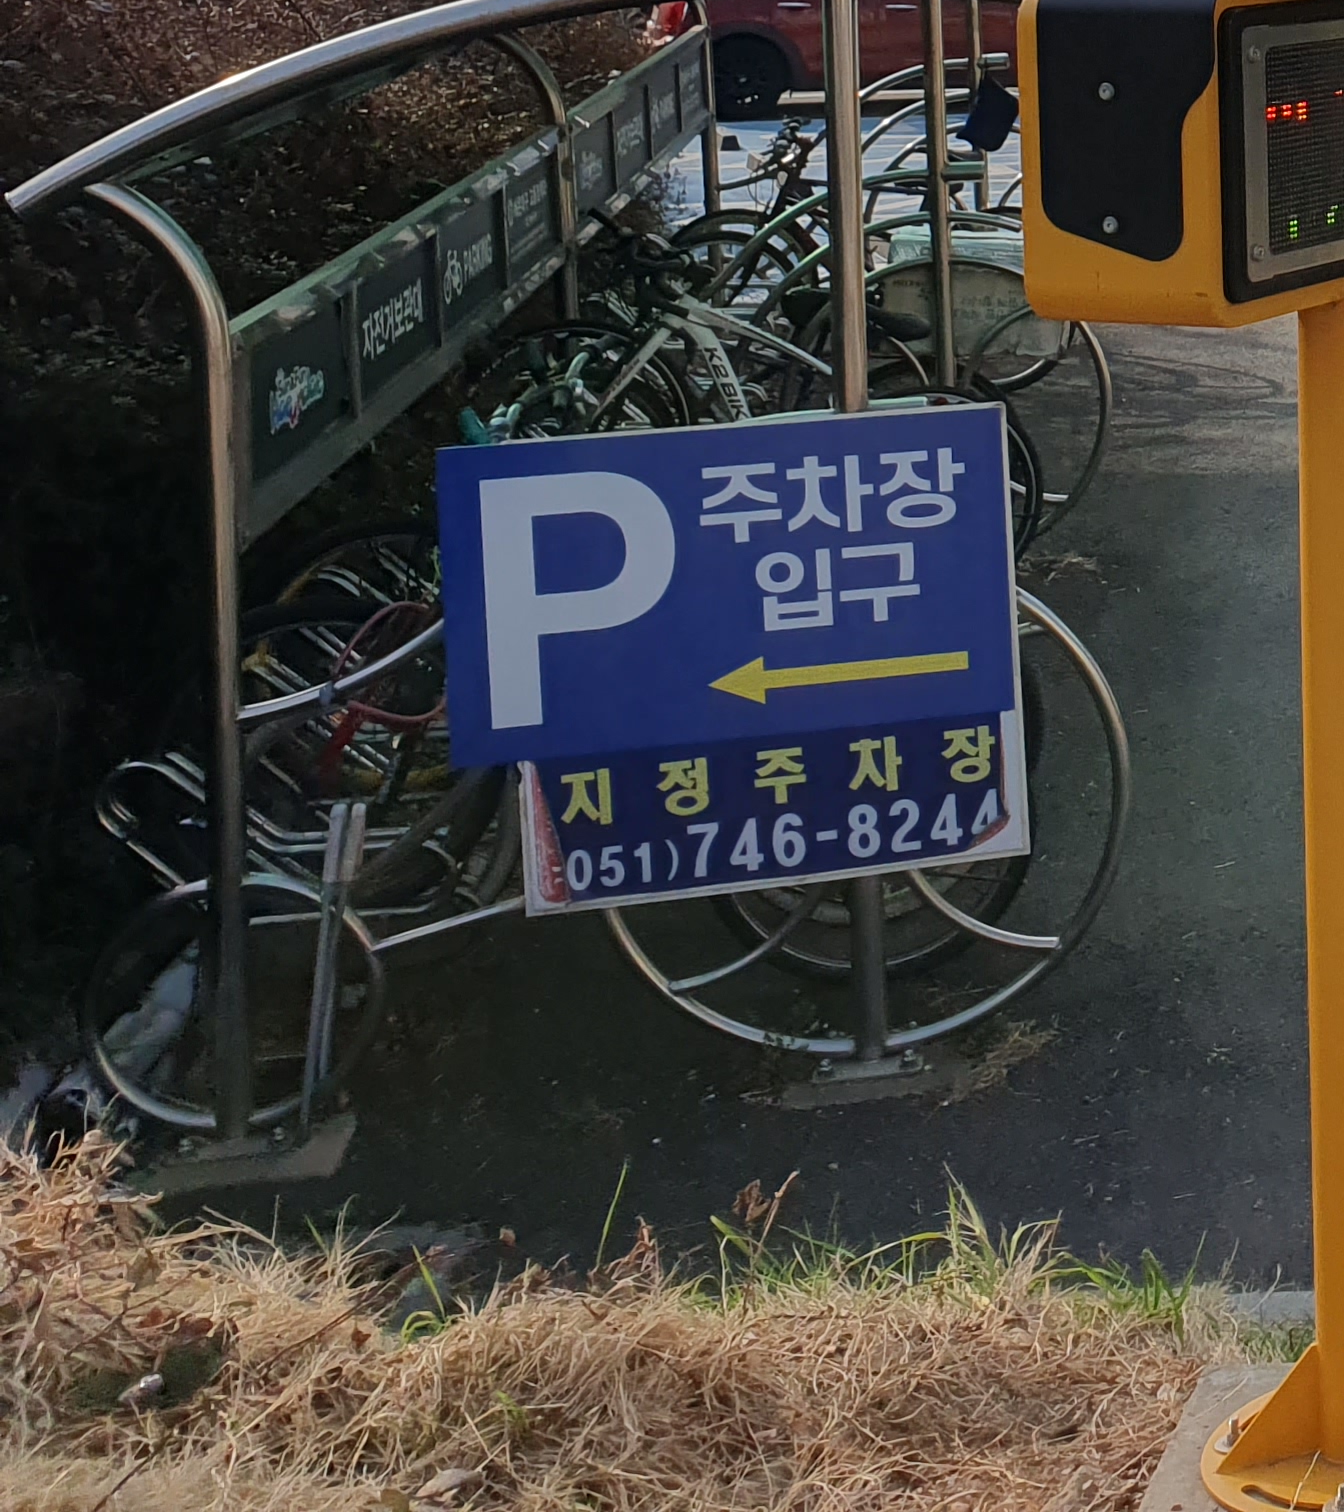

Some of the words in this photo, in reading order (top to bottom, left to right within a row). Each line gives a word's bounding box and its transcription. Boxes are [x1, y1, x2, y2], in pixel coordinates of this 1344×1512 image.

[703, 347, 729, 380] K2
[720, 382, 749, 421] BIK
[699, 447, 965, 543] 주차장
[479, 471, 675, 729] P
[755, 541, 921, 631] 입구
